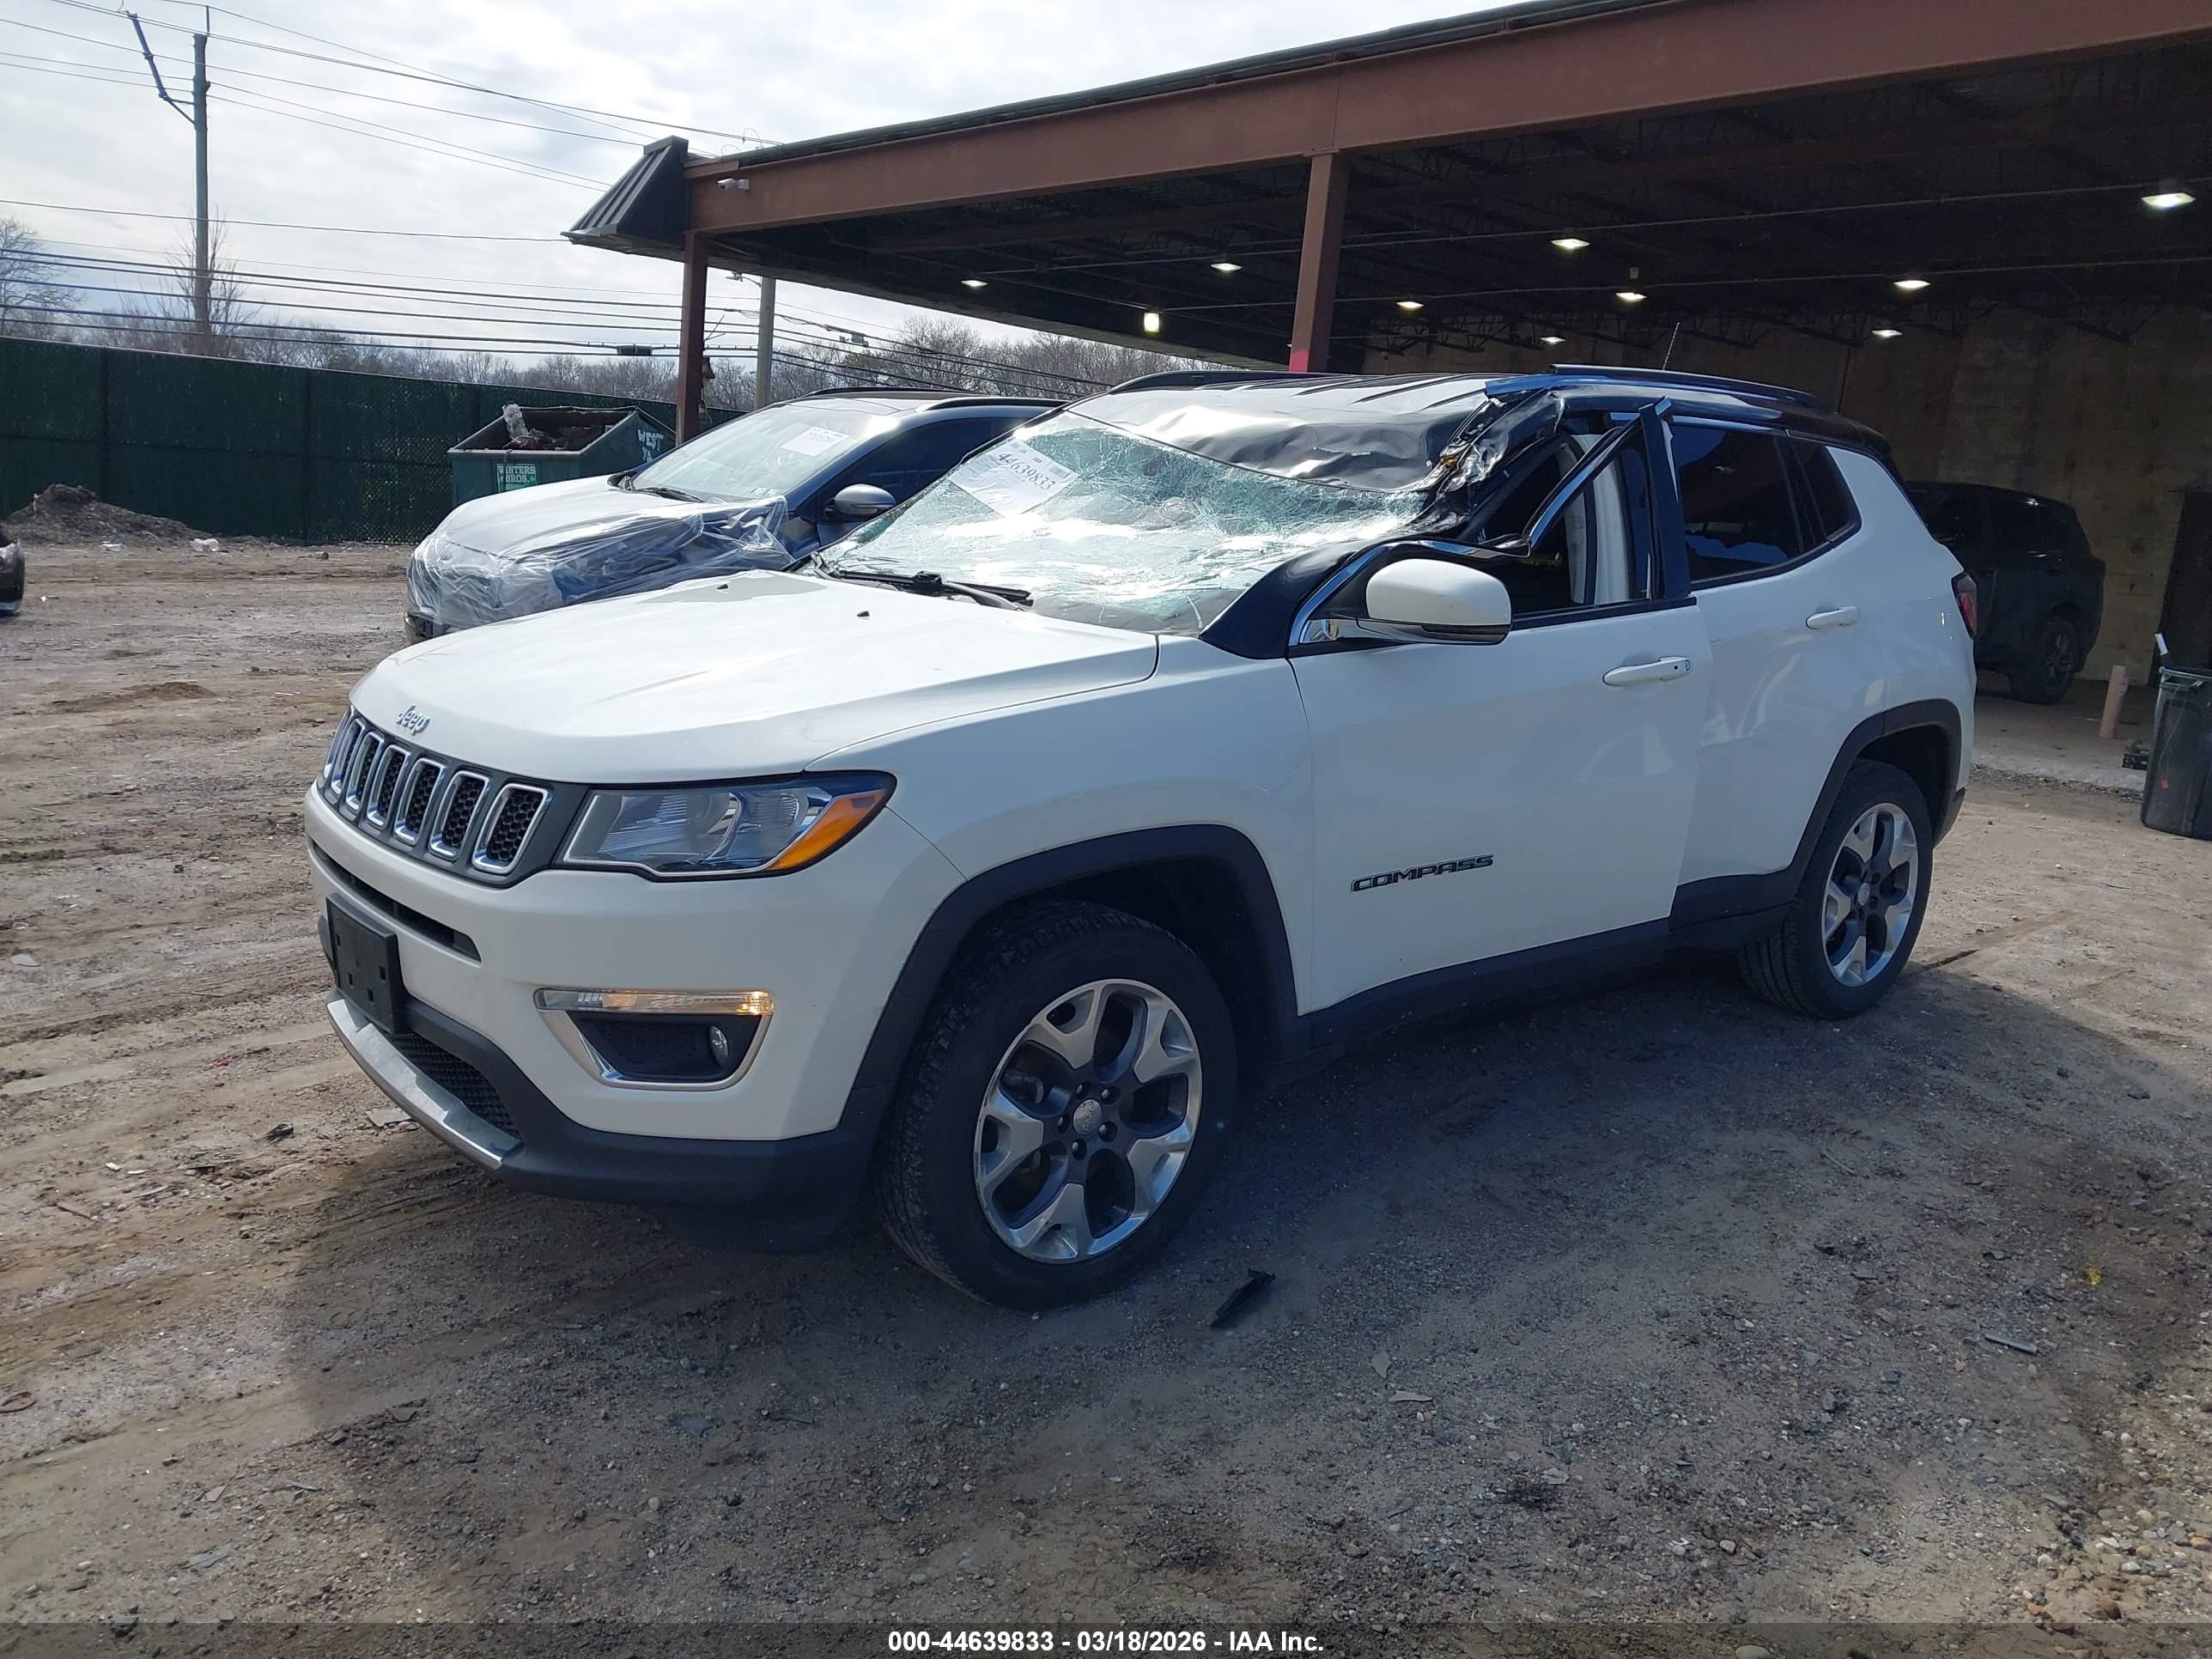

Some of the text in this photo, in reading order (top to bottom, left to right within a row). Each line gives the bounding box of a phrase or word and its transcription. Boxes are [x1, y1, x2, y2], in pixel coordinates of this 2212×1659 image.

[637, 428, 665, 452] WEST
[497, 465, 536, 475] WINTERS
[505, 474, 531, 483] BROS.
[997, 452, 1056, 491] 44639833
[396, 703, 431, 736] Jeep
[1351, 853, 1495, 892] COMPASS
